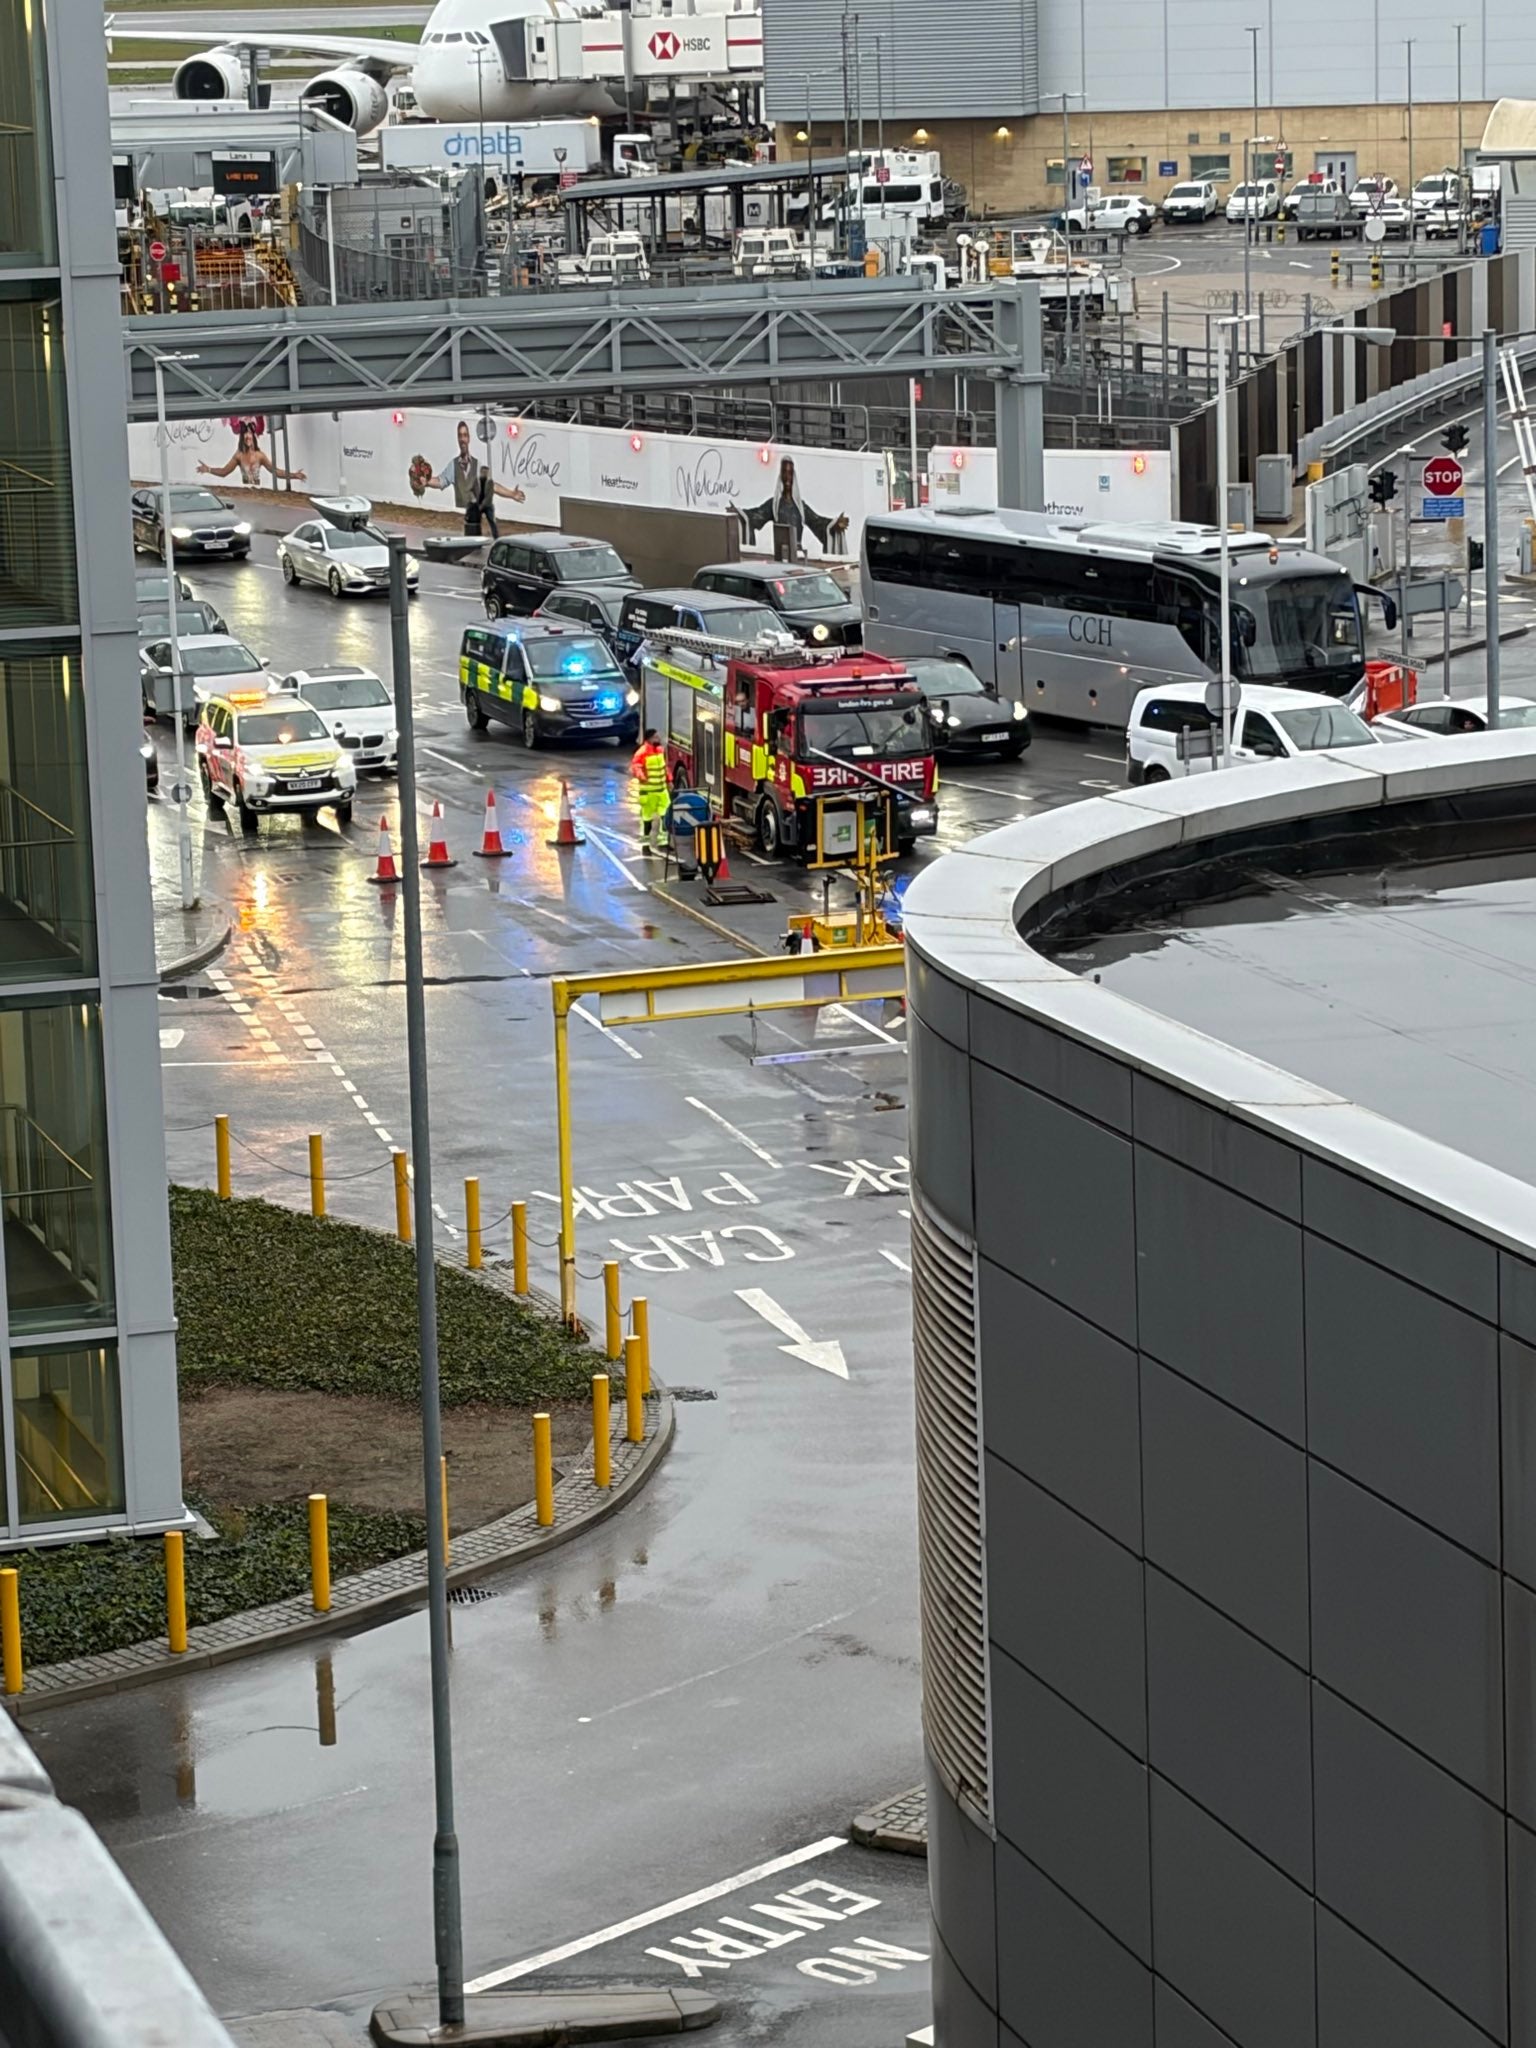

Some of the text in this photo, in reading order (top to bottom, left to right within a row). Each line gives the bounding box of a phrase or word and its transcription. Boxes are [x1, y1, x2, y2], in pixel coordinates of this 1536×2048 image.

[683, 37, 711, 51] HSBC
[444, 131, 522, 156] dnata
[501, 433, 561, 486] Welcome
[676, 448, 740, 507] Welcome
[1425, 471, 1461, 483] STOP
[1069, 614, 1112, 647] CCH
[881, 761, 924, 781] FIRE
[531, 1172, 760, 1220] PARK
[609, 1225, 796, 1272] CAR
[644, 1879, 882, 1977] ENTRY
[796, 1937, 931, 1986] NO
